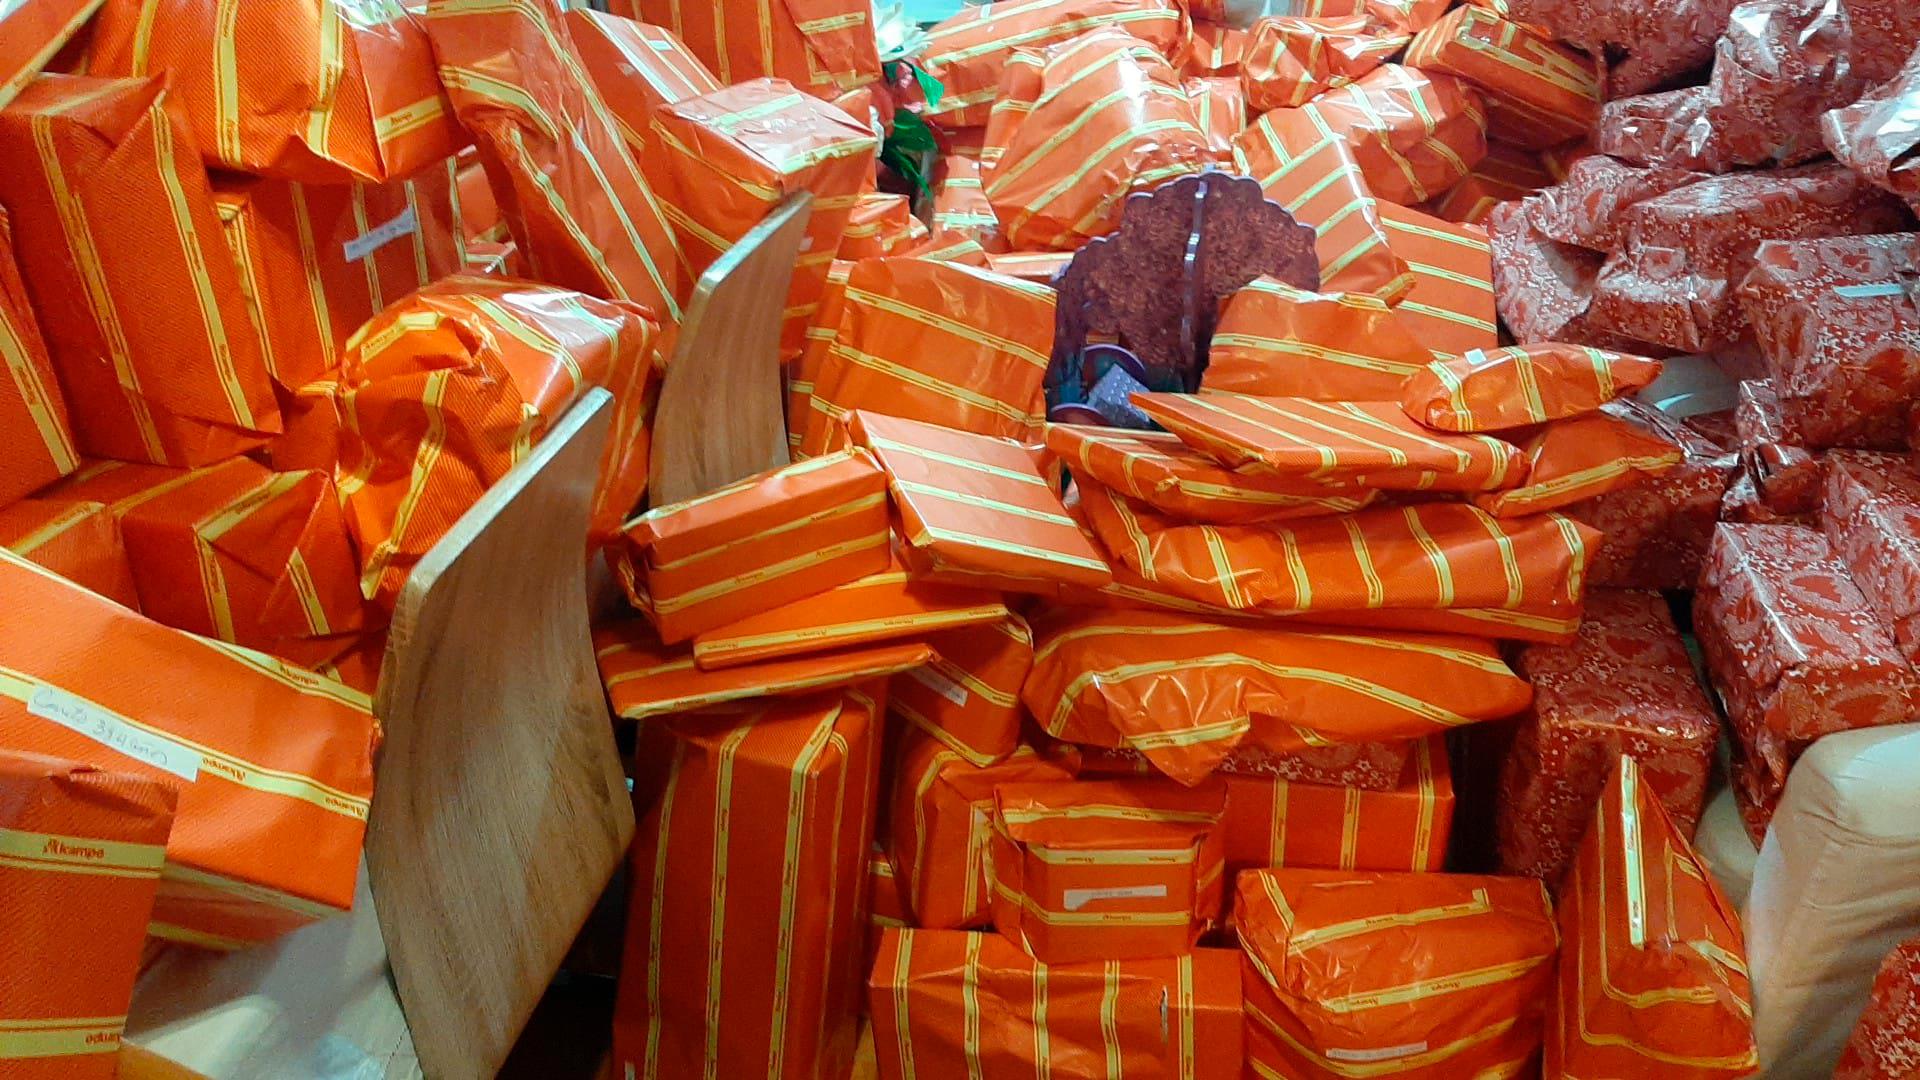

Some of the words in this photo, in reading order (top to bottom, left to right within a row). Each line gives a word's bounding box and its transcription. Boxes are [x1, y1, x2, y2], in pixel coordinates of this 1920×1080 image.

[279, 665, 320, 687] Alcampo
[202, 757, 247, 782] Alcampo
[324, 796, 365, 817] Alcampo
[43, 838, 105, 859] Alcampo
[85, 1032, 121, 1046] ampo
